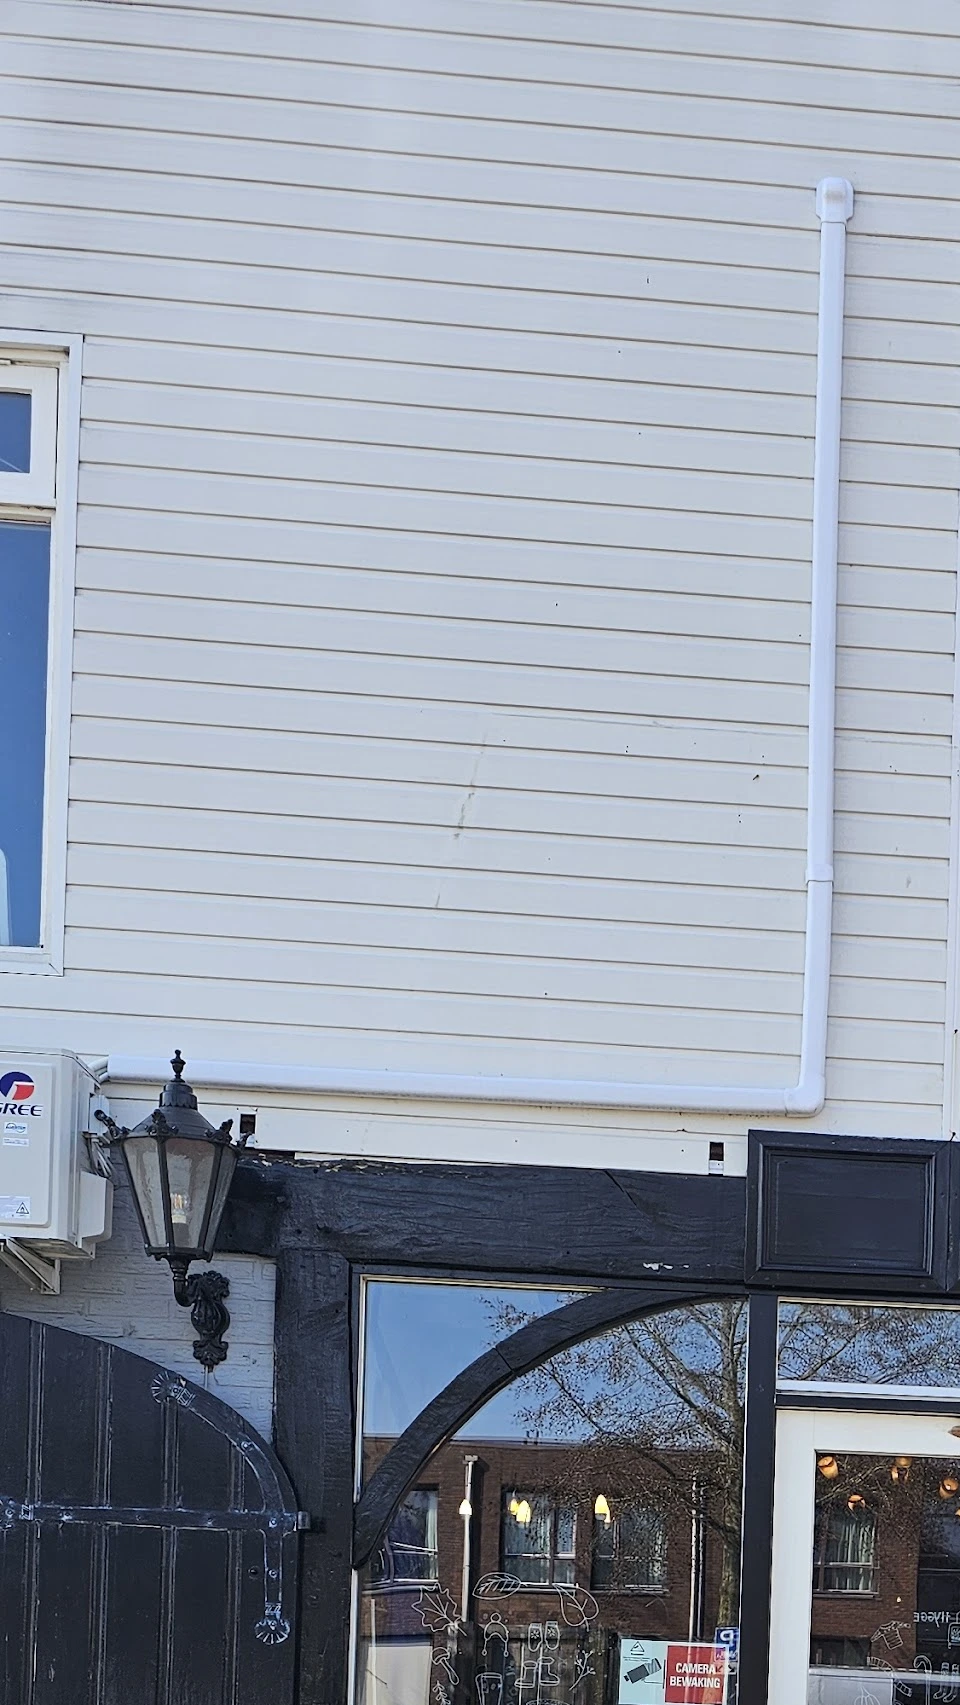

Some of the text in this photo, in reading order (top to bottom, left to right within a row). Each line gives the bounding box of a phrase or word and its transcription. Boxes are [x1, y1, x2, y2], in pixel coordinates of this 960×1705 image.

[0, 1102, 43, 1117] REE
[675, 1662, 717, 1675] CAMERA
[669, 1675, 721, 1689] BEWAKING
